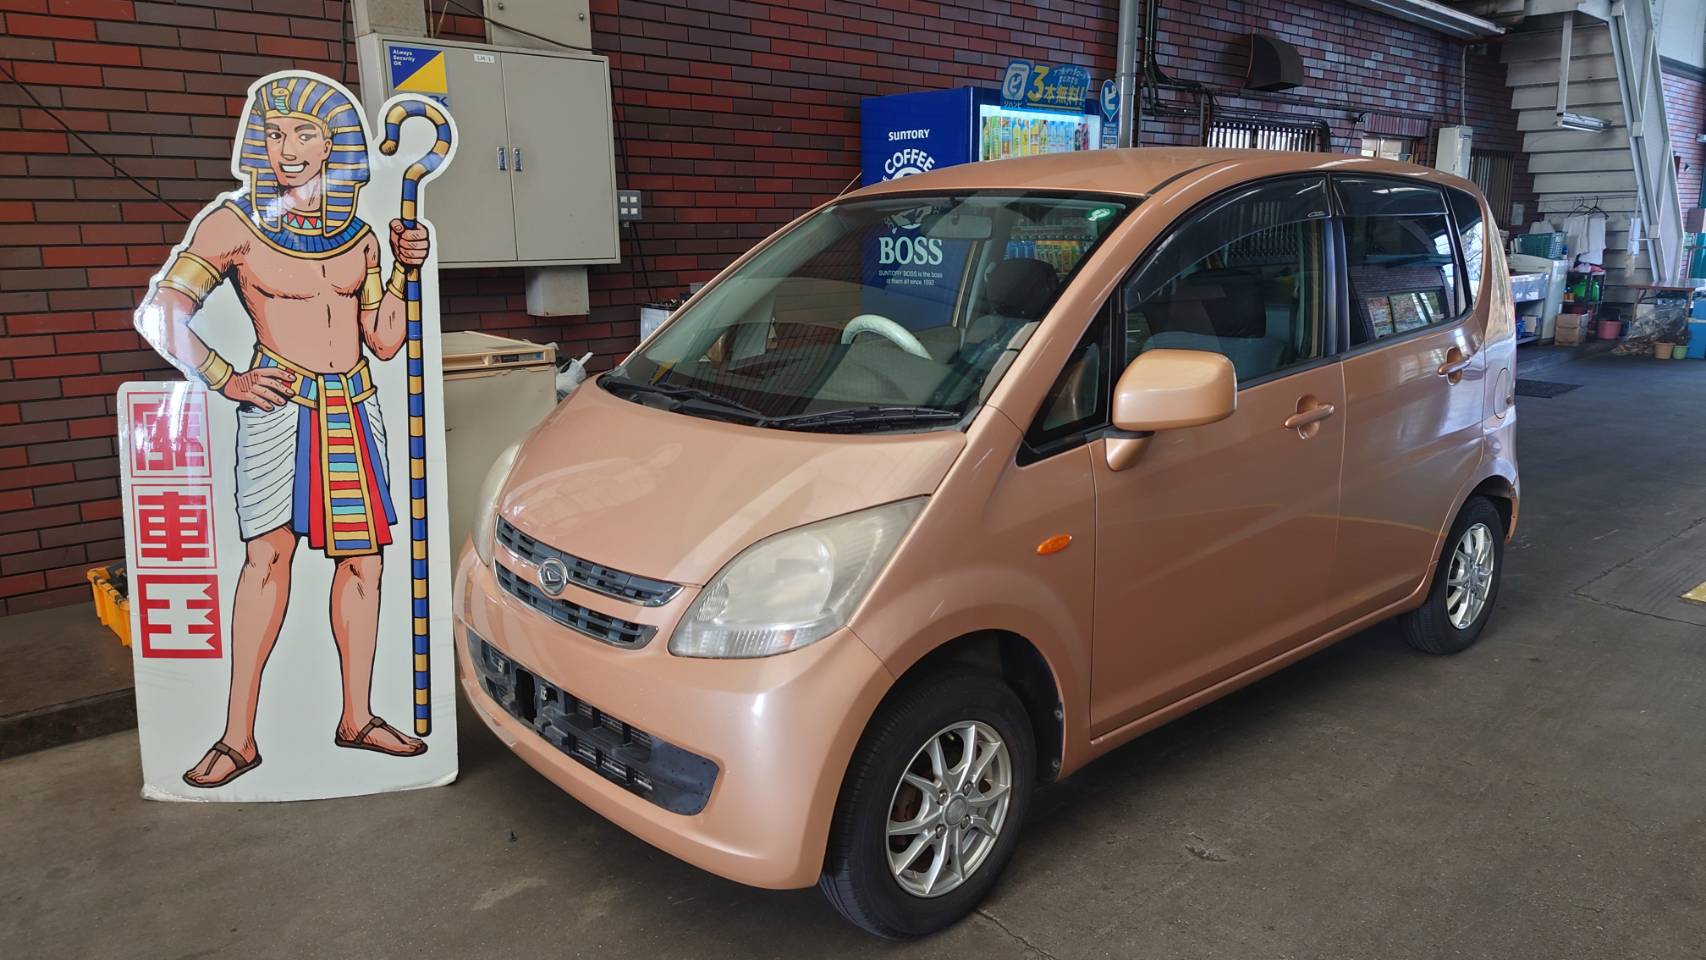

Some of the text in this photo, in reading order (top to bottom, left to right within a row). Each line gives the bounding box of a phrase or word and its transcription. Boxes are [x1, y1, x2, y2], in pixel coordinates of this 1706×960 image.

[393, 55, 416, 63] Security
[888, 128, 930, 141] SUNTORY
[884, 148, 936, 175] COFFEE
[879, 236, 944, 266] BOSS
